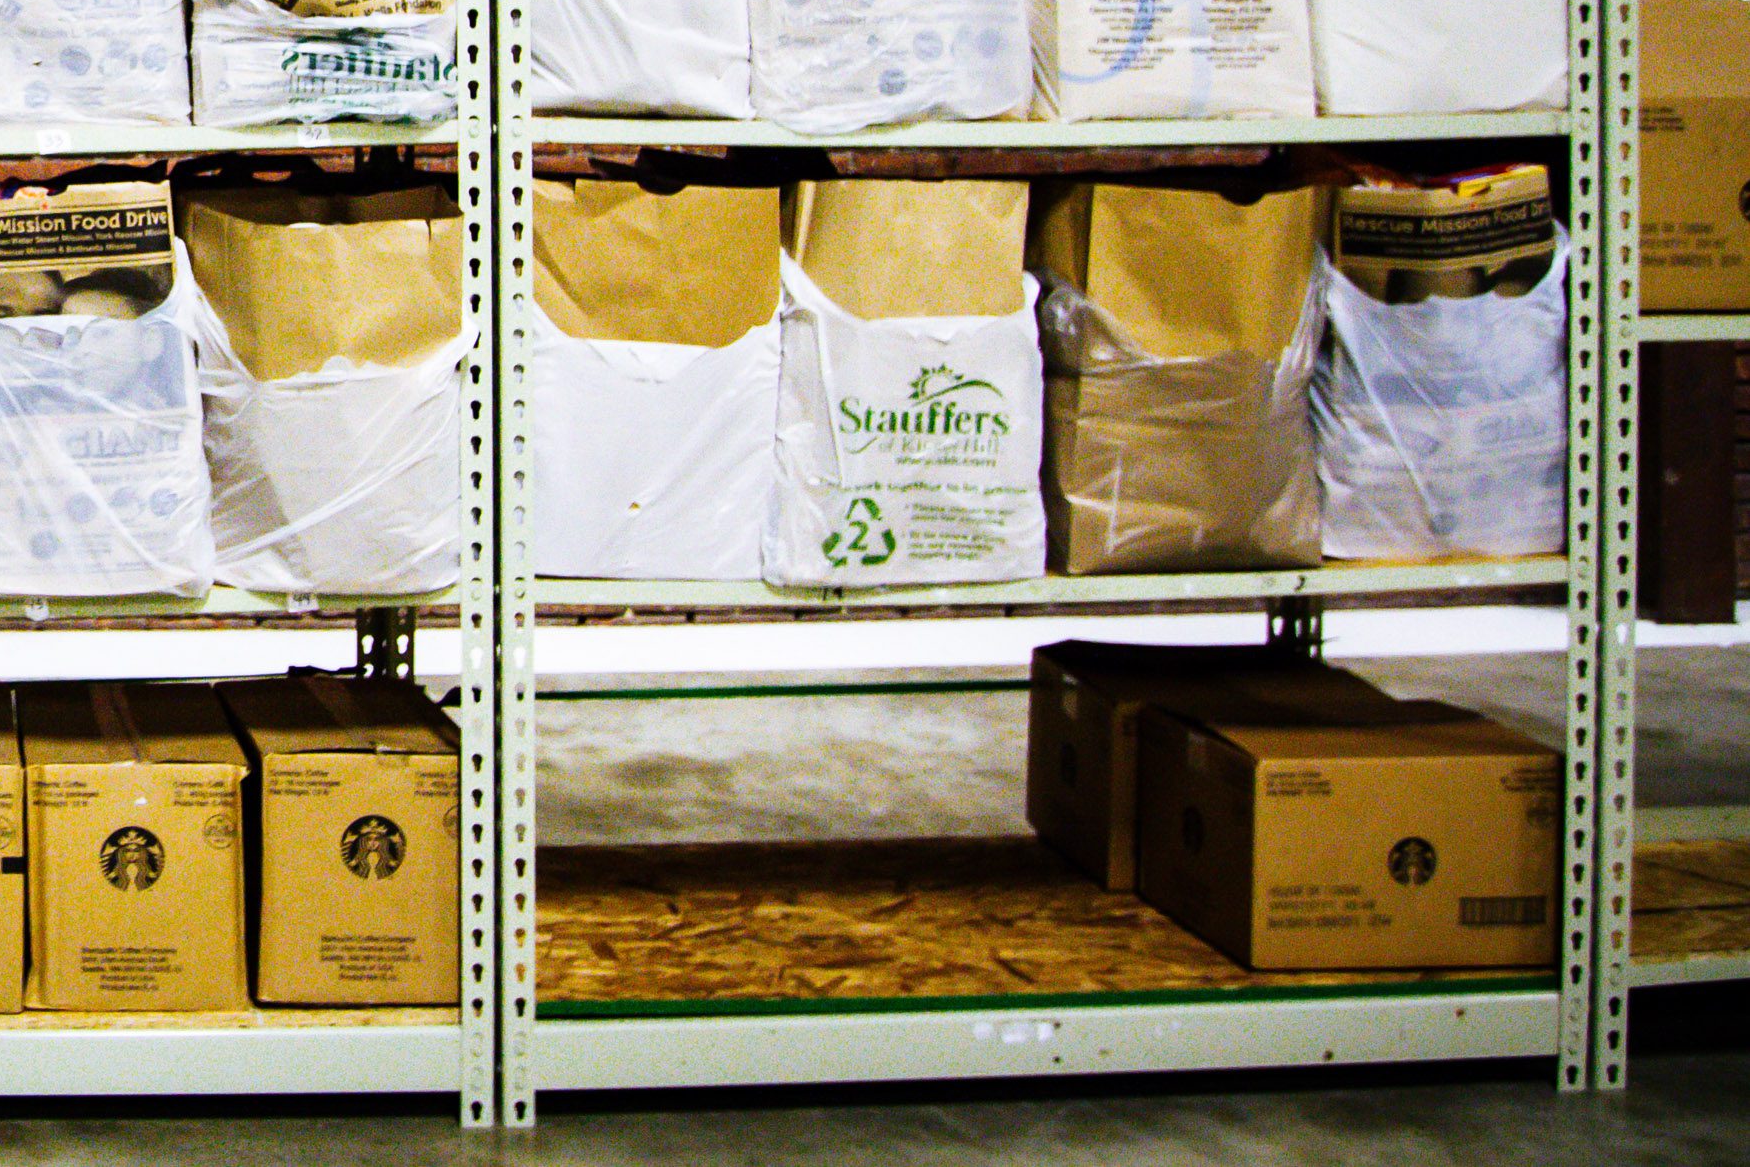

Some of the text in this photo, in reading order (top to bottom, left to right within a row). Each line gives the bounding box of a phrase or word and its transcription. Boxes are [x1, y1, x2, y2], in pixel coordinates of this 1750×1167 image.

[71, 213, 120, 230] Food
[125, 211, 167, 227] Drive
[1421, 215, 1490, 233] Mission
[839, 396, 1010, 434] Stauffers
[848, 520, 869, 551] 2
